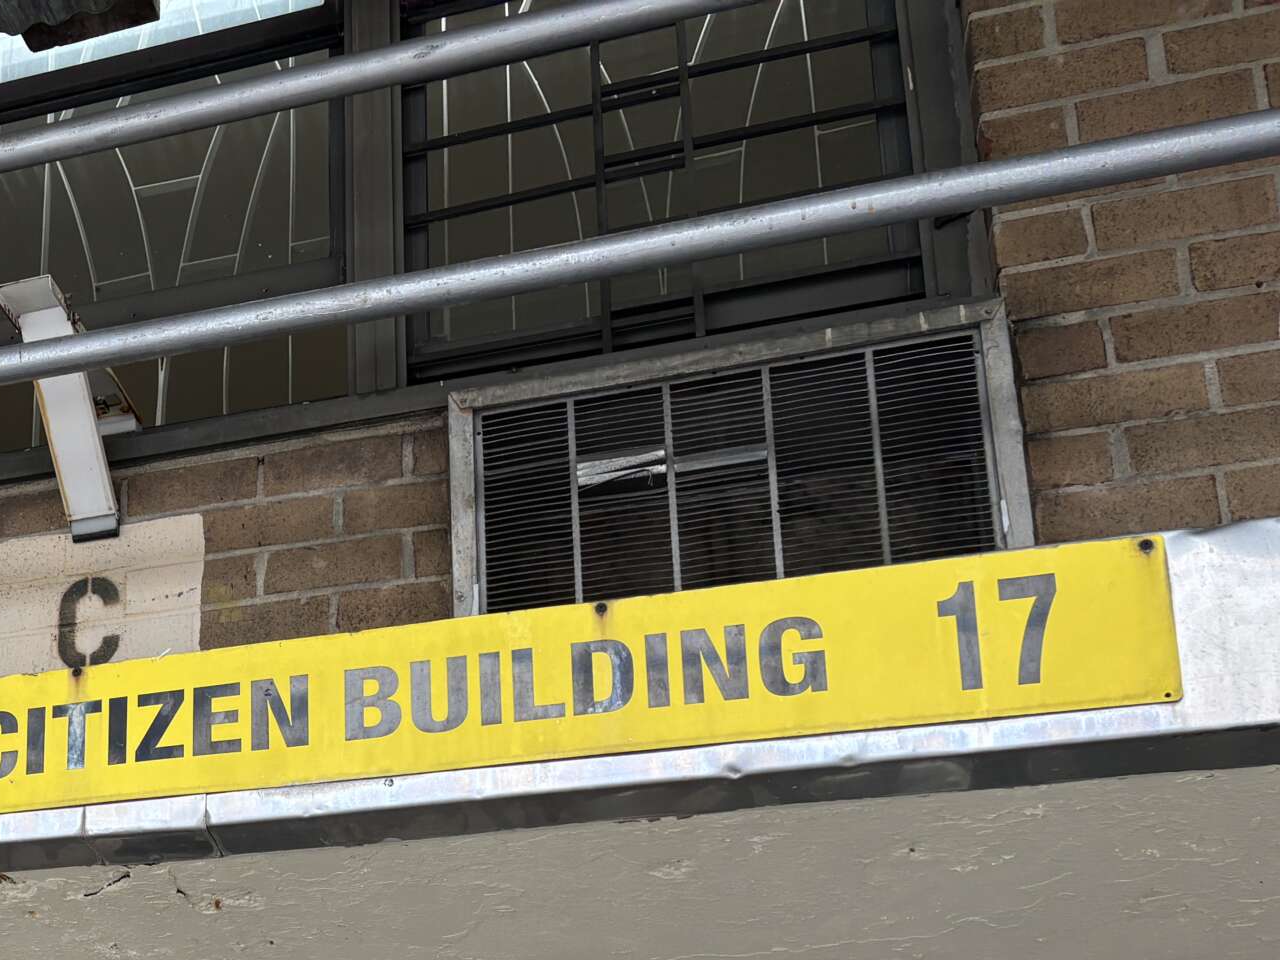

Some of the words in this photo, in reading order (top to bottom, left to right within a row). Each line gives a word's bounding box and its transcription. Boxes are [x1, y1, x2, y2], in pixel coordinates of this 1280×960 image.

[57, 576, 120, 667] C
[344, 616, 828, 742] BUILDING
[936, 572, 1057, 692] 17
